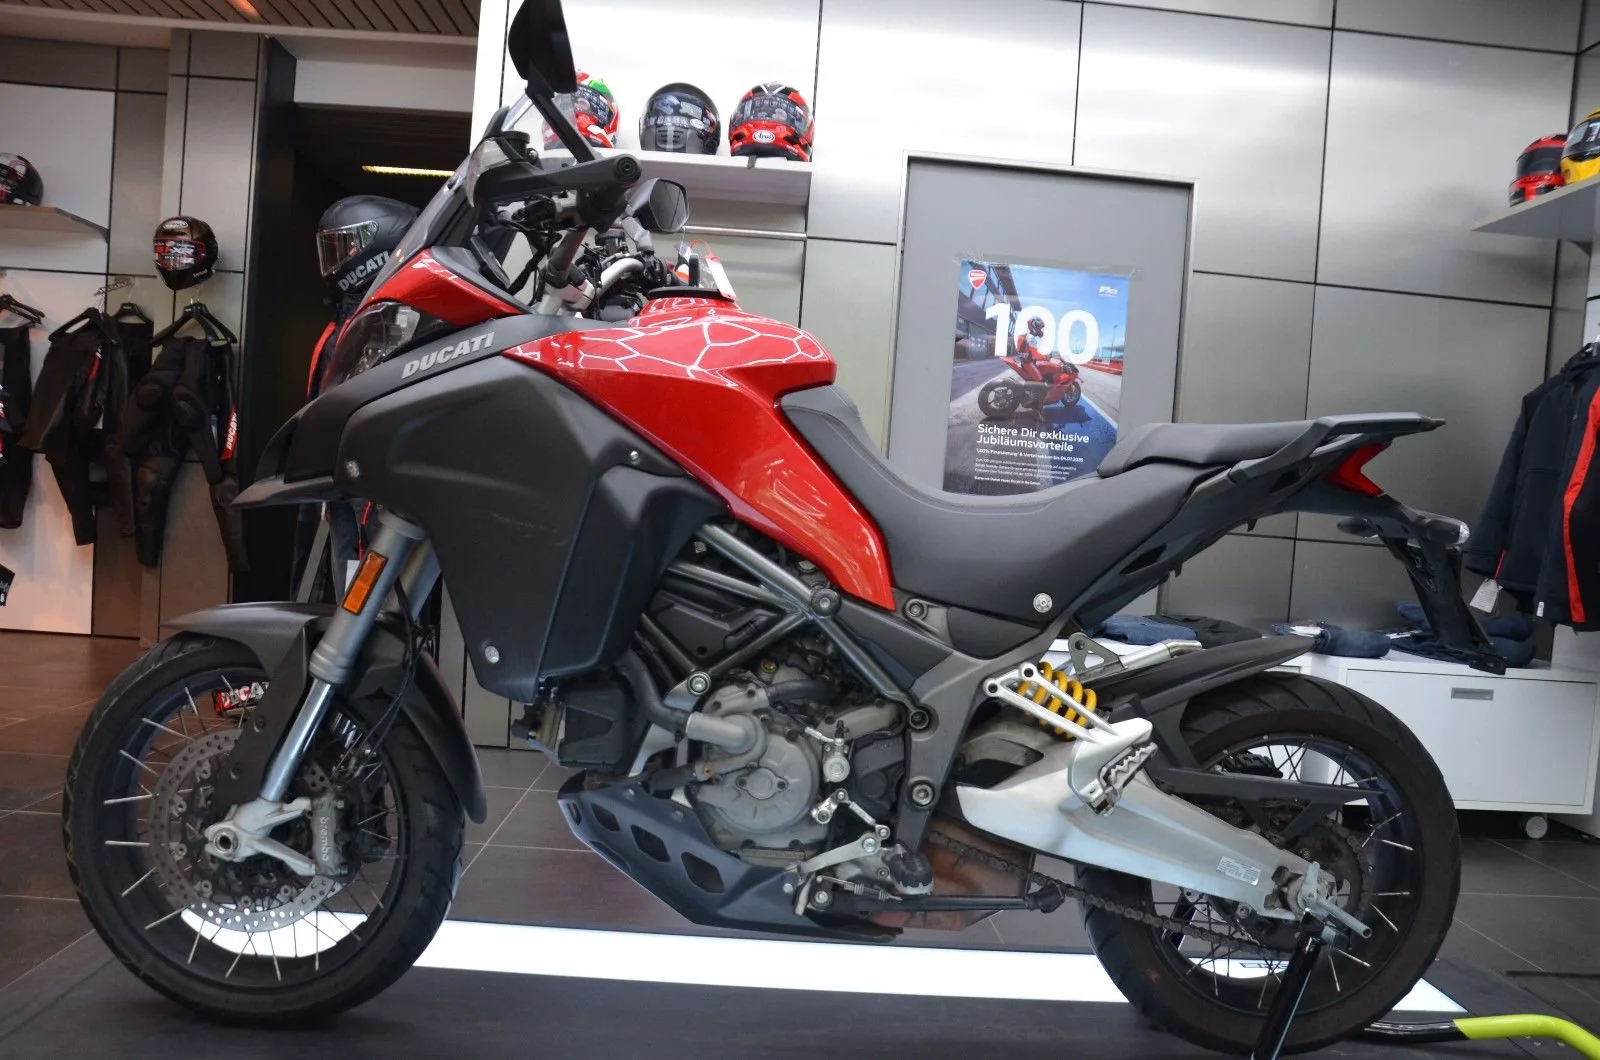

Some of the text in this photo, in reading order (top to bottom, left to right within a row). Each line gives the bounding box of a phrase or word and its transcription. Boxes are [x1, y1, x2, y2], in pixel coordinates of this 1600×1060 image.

[338, 251, 390, 291] DUCATI
[986, 303, 1099, 364] 100
[401, 332, 495, 379] DUCATI
[976, 435, 1074, 451] Jubiläumsvorteile
[978, 424, 1089, 443] Sichere Dir exklusive
[320, 816, 332, 861] brembo
